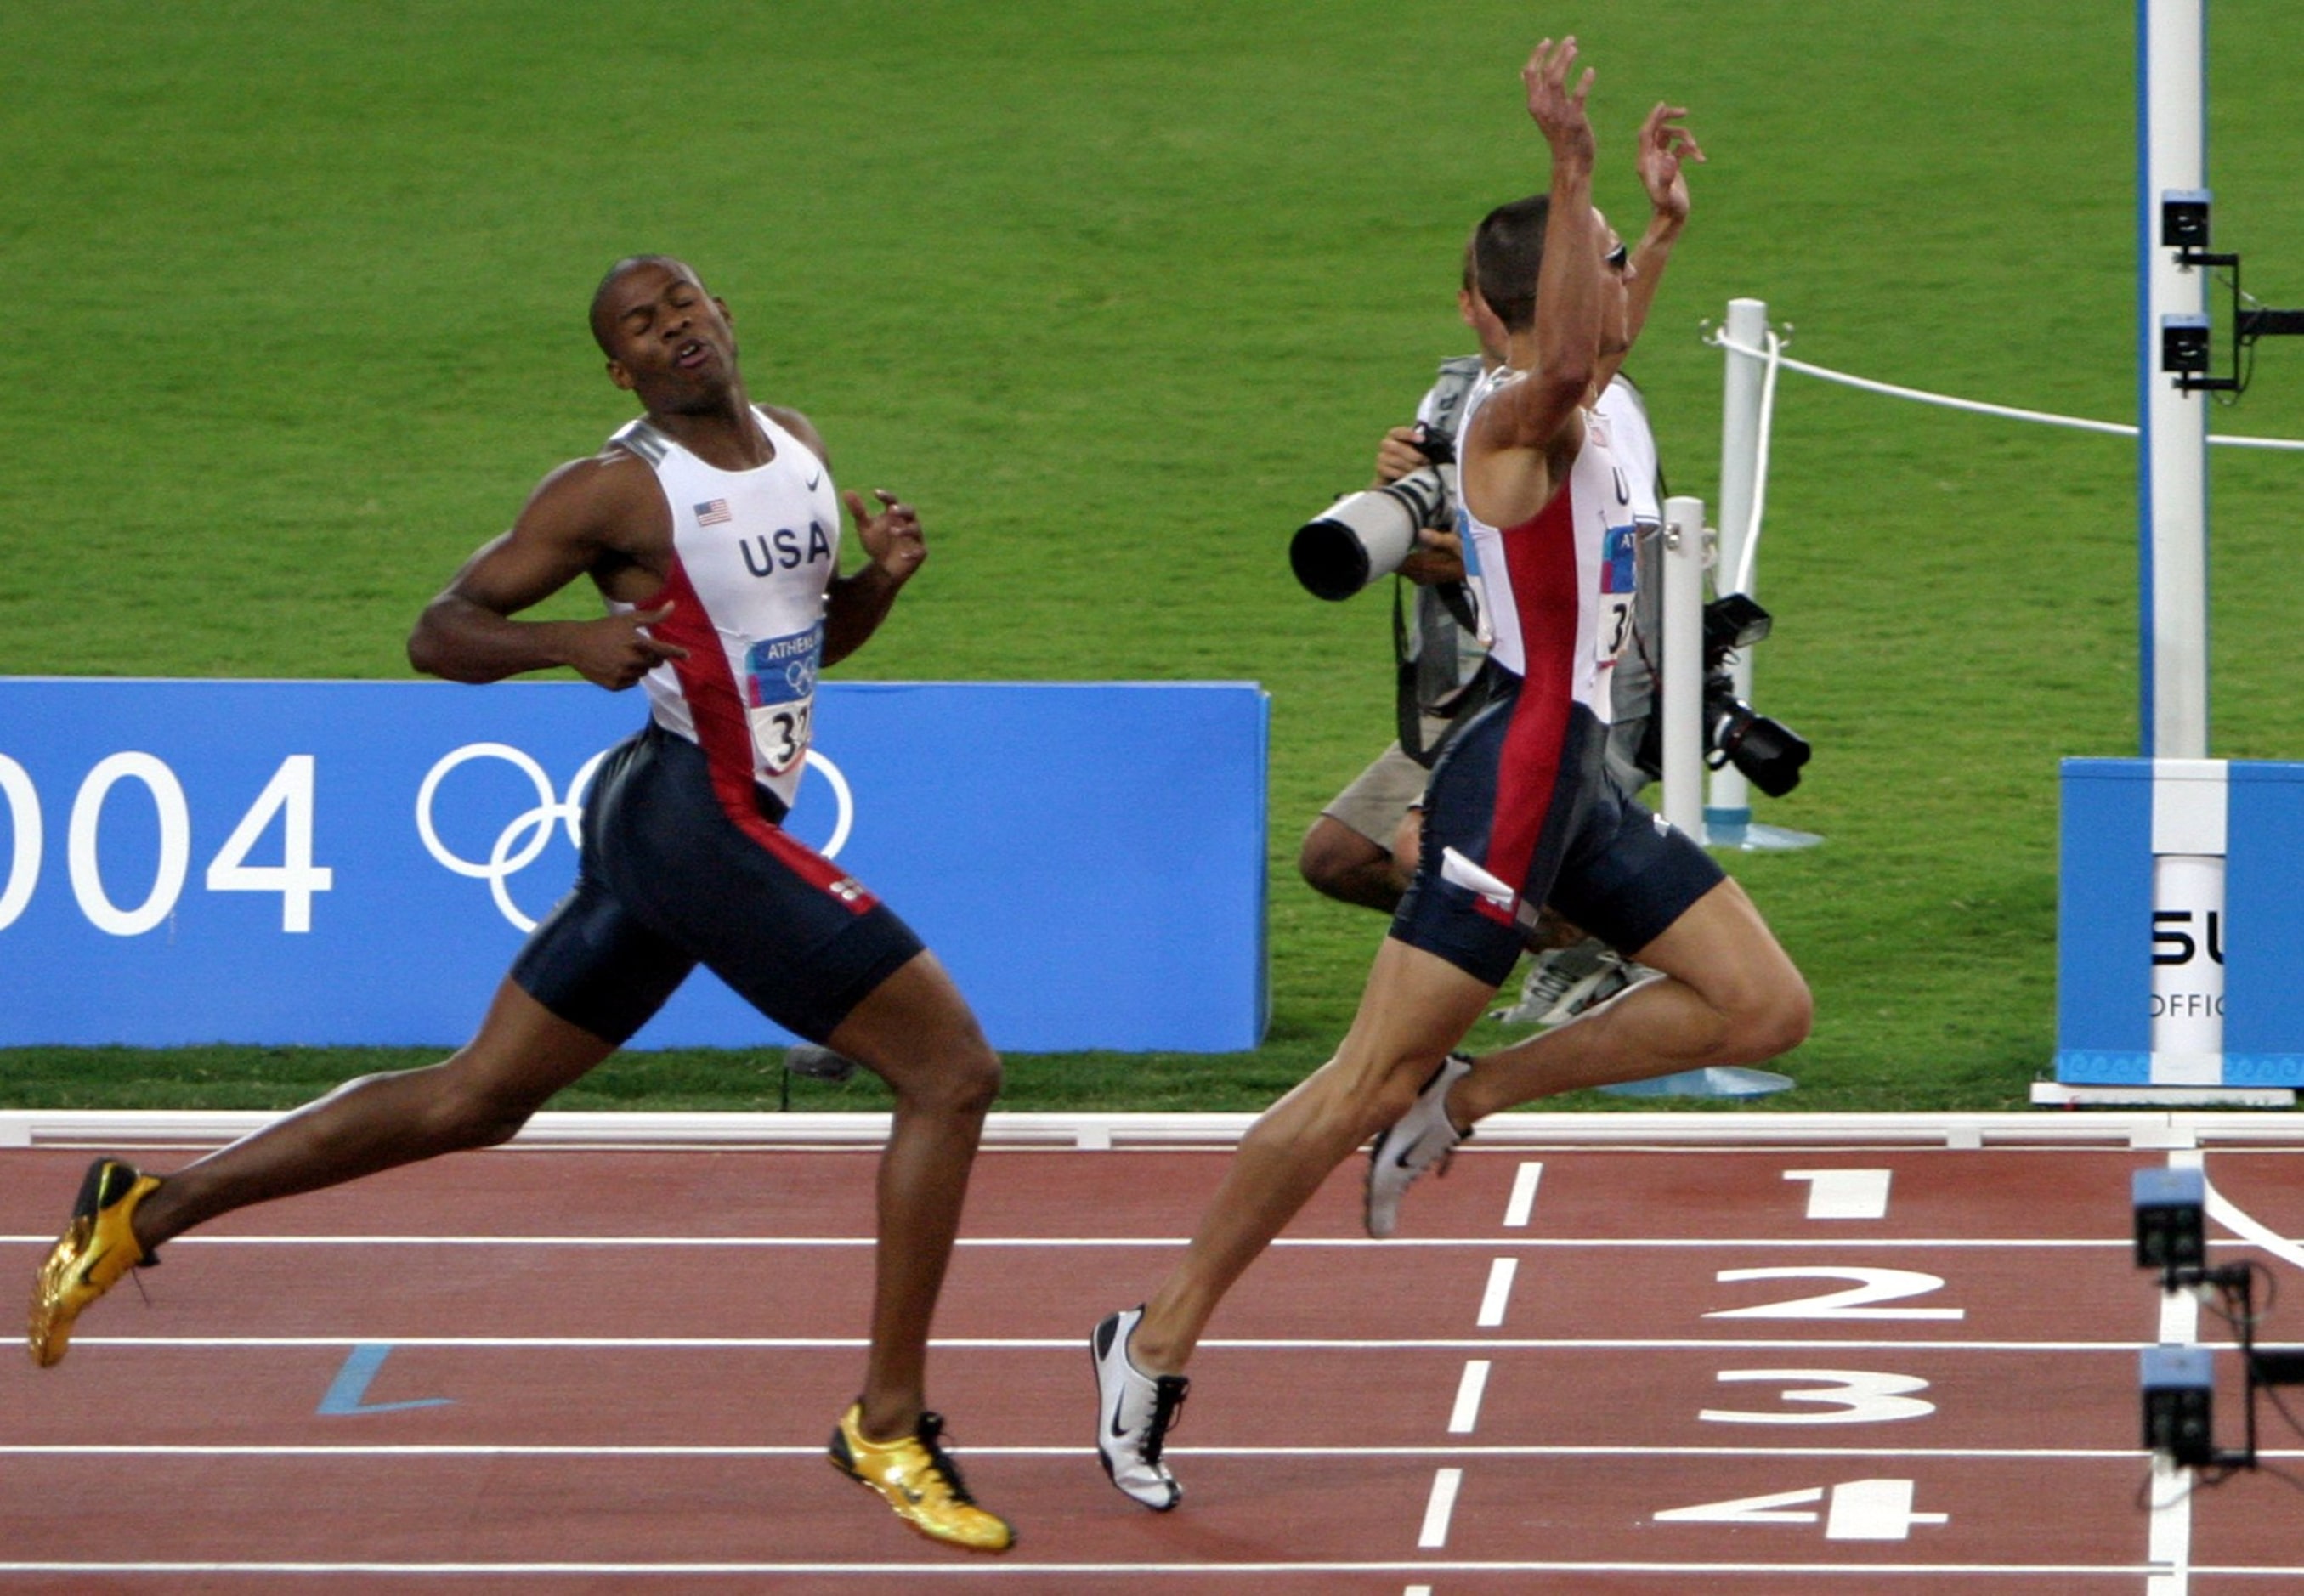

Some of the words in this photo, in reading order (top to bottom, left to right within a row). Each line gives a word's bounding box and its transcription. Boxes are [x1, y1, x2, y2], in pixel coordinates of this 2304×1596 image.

[739, 520, 831, 578] USA
[1782, 1169, 1893, 1219] 1
[1700, 1265, 1965, 1320] 2
[1698, 1368, 1937, 1424] 3
[1652, 1479, 1949, 1540] 4
